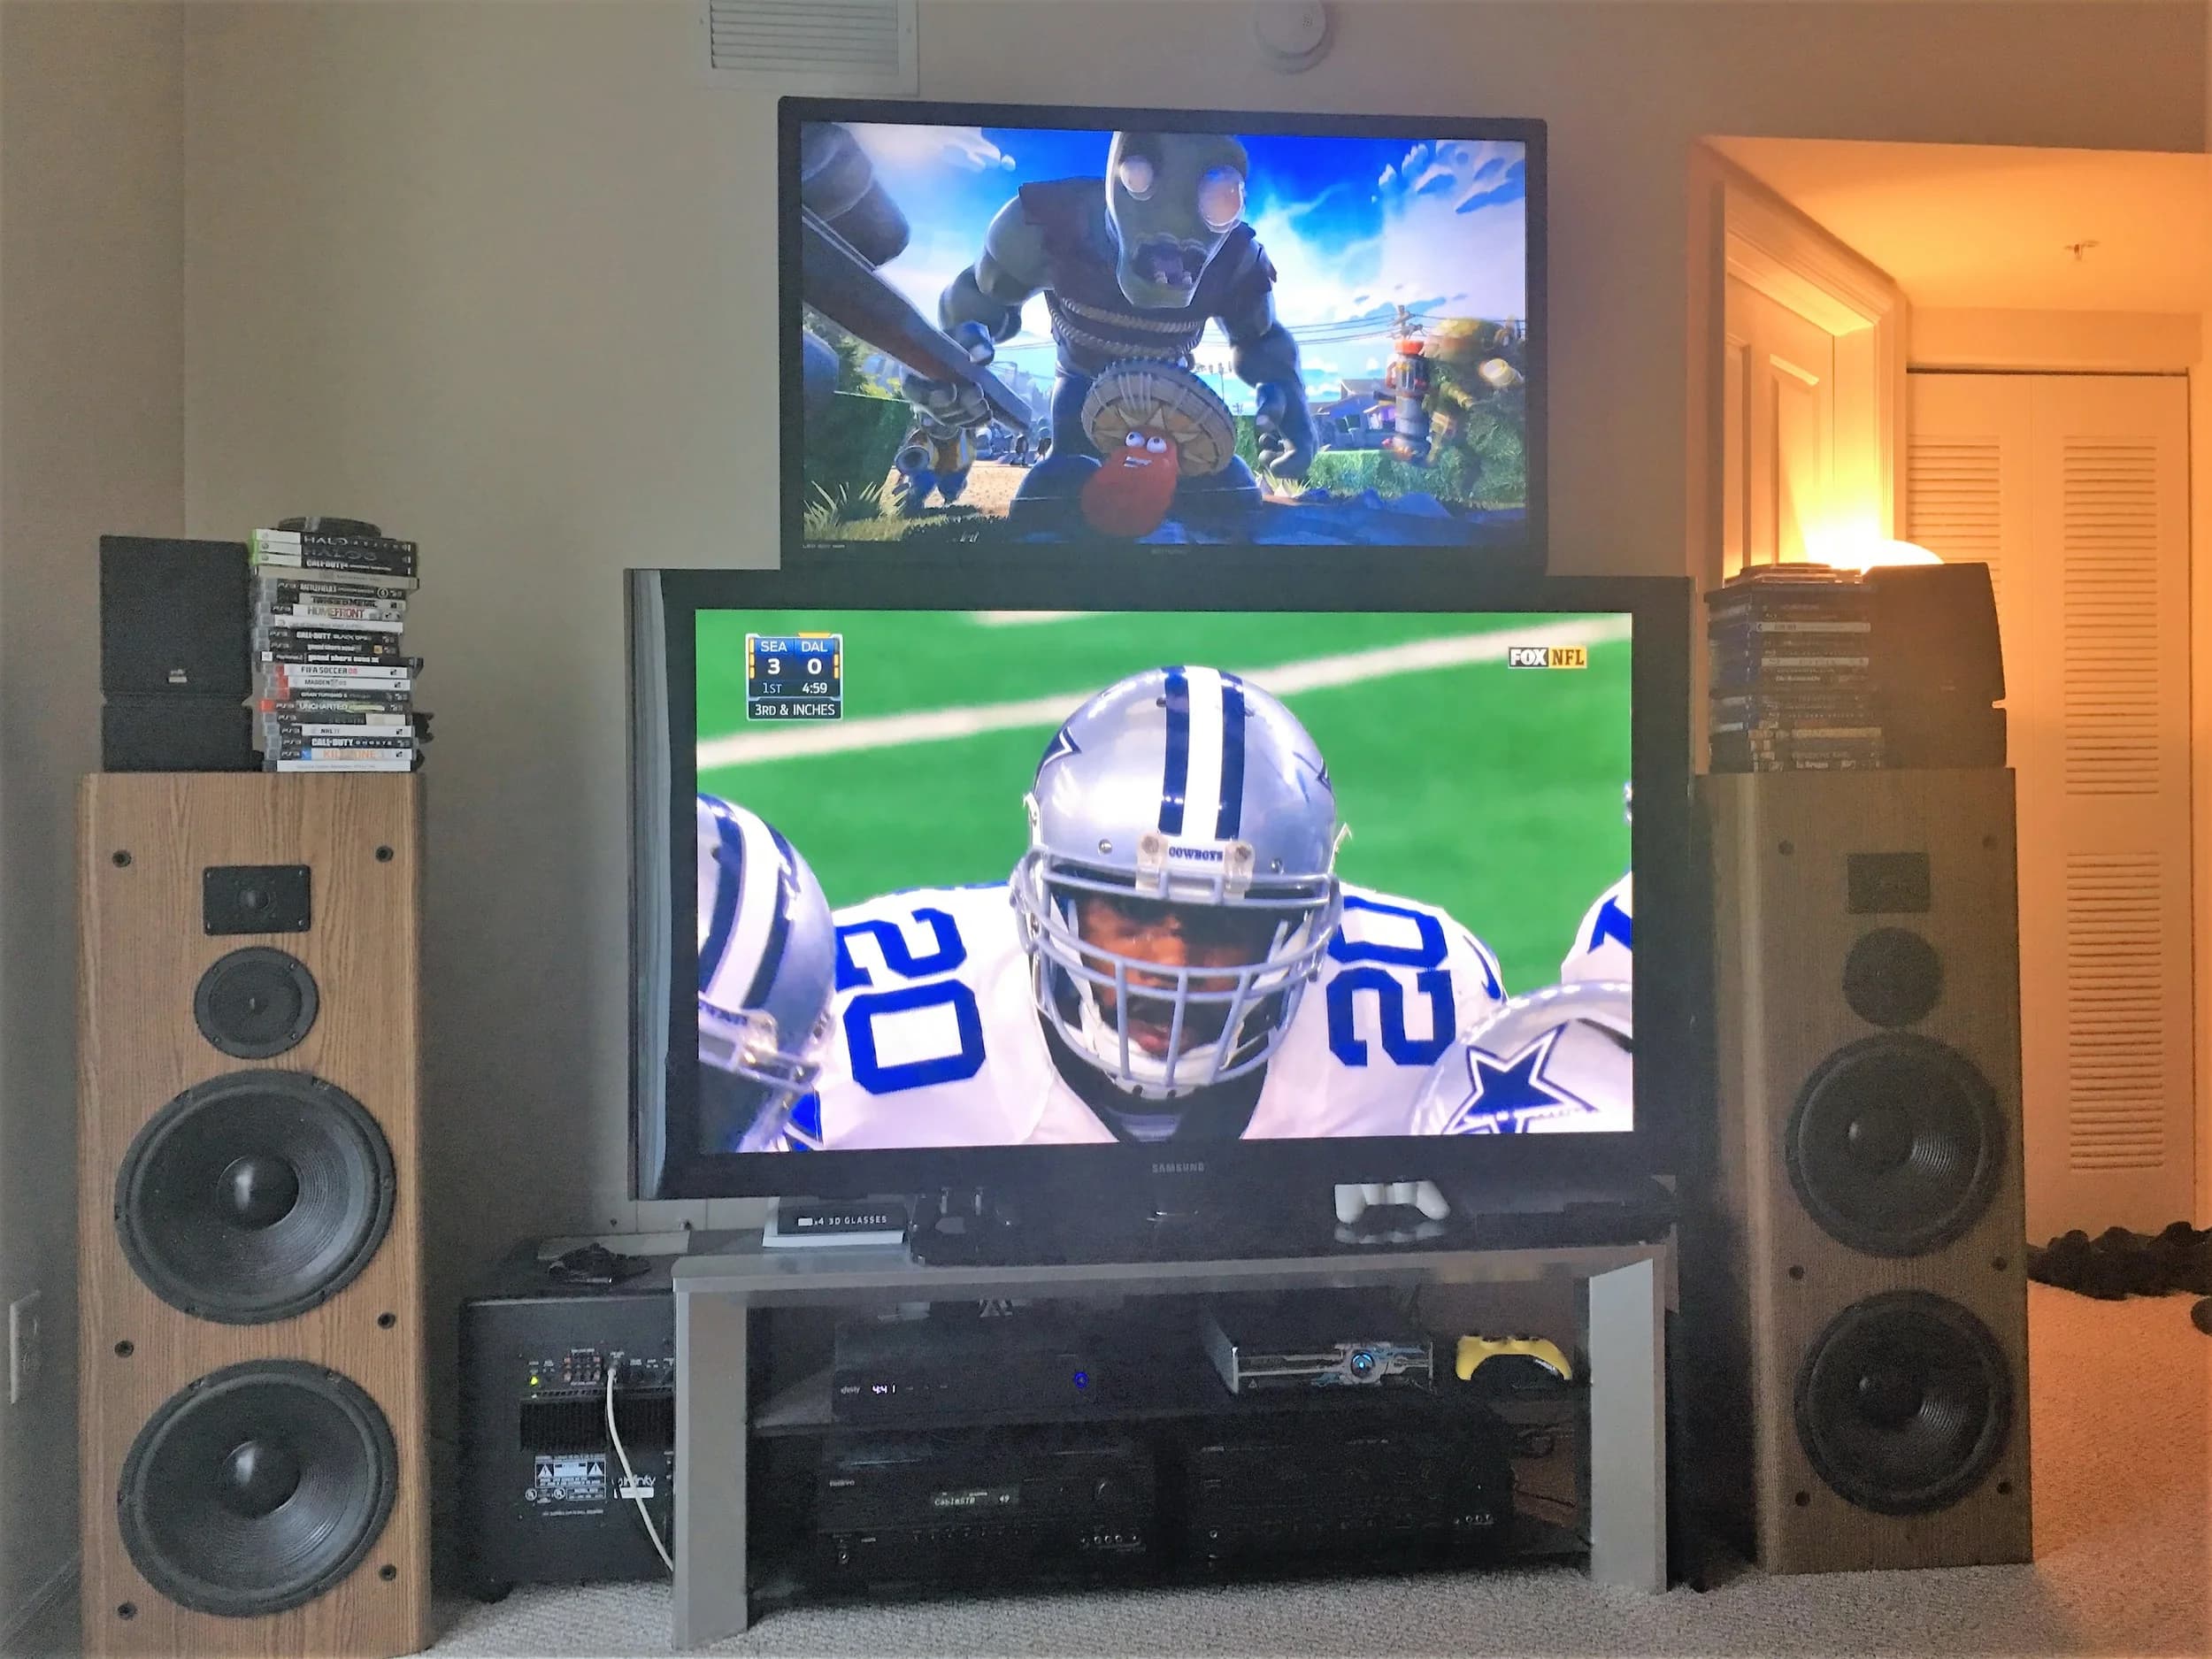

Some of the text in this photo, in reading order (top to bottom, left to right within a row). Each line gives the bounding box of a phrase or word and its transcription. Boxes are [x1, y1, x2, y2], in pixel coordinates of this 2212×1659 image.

[303, 534, 348, 546] HALO
[760, 641, 828, 652] SEA DAL
[1510, 649, 1585, 665] FOX NFL
[767, 657, 822, 674] 3 0
[763, 682, 828, 694] 1ST 4:59
[755, 703, 835, 716] 3RD & INCHES
[1168, 846, 1224, 862] COWBOYS
[834, 908, 986, 1094] 20
[1152, 1162, 1204, 1173] SAMSUNG
[844, 1215, 887, 1225] GLASSES
[872, 1384, 895, 1394] 4:41
